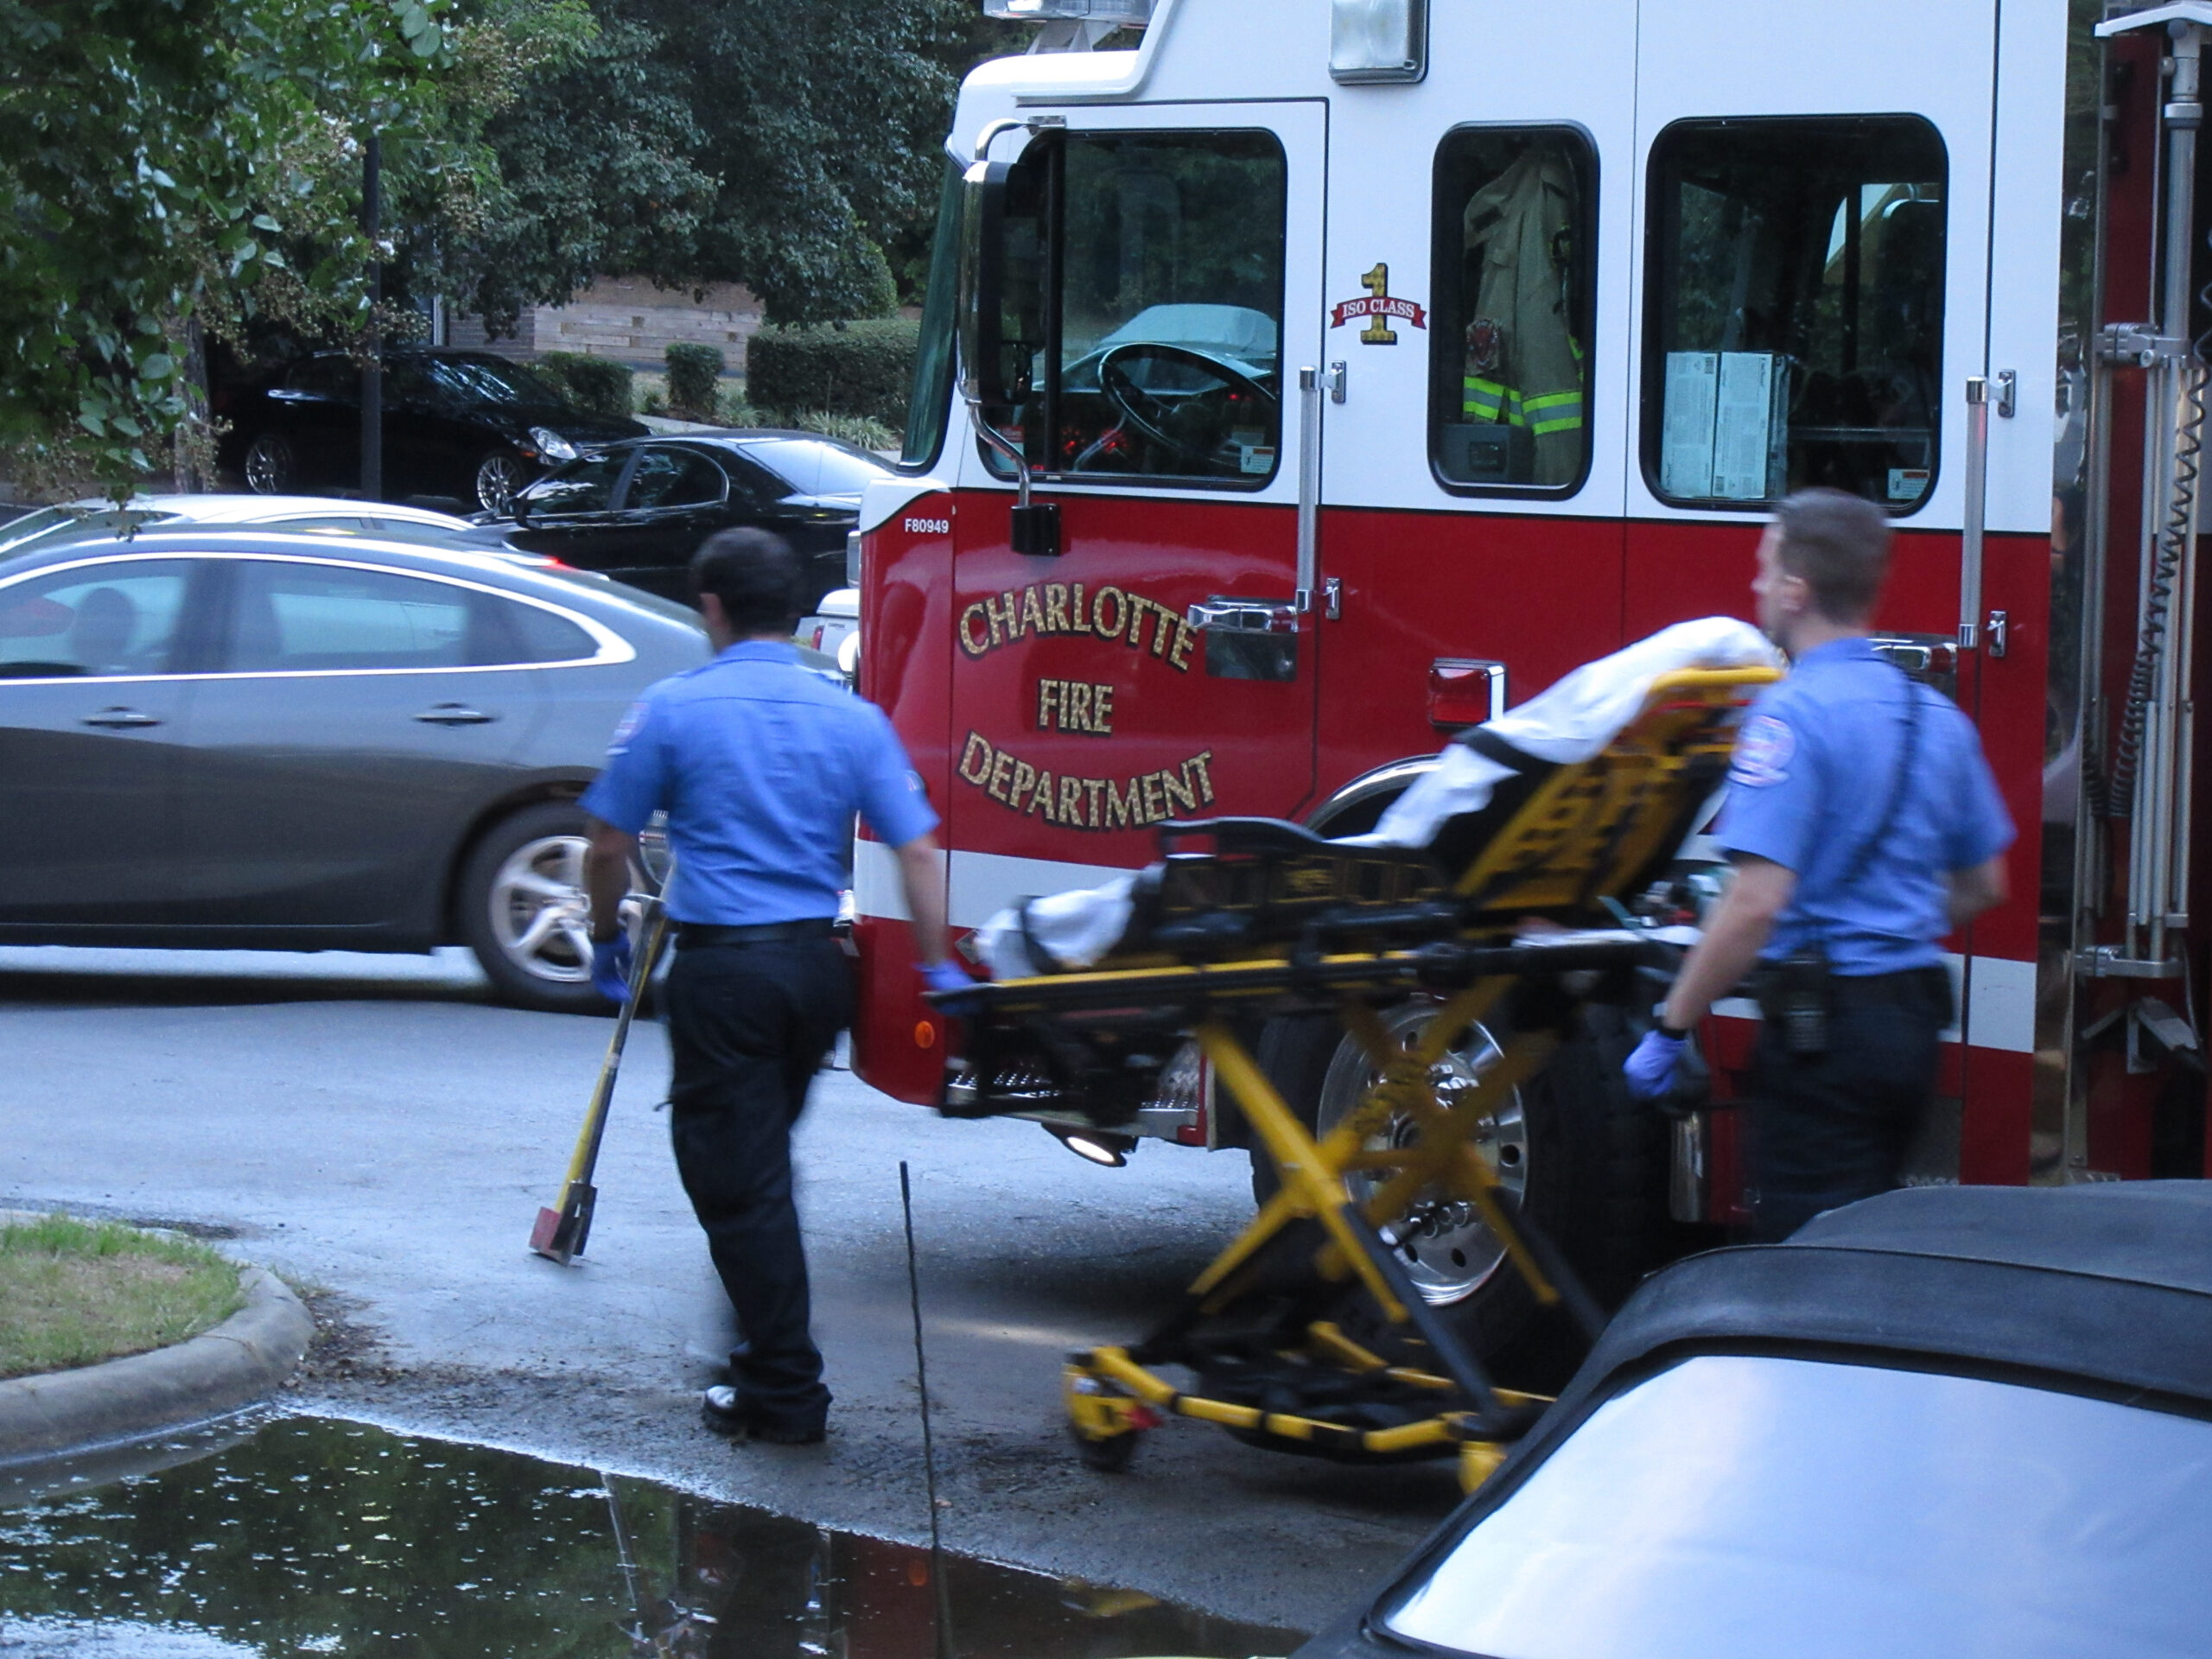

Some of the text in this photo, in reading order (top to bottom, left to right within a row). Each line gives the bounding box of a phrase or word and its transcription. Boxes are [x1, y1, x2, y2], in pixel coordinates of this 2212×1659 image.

[1342, 298, 1415, 319] ISO CLASS
[1361, 263, 1397, 345] 1
[905, 518, 949, 533] F80949
[959, 582, 1198, 671] CHARLOTTE
[1039, 678, 1114, 734] FIRE
[958, 731, 1215, 829] DEPARTMENT
